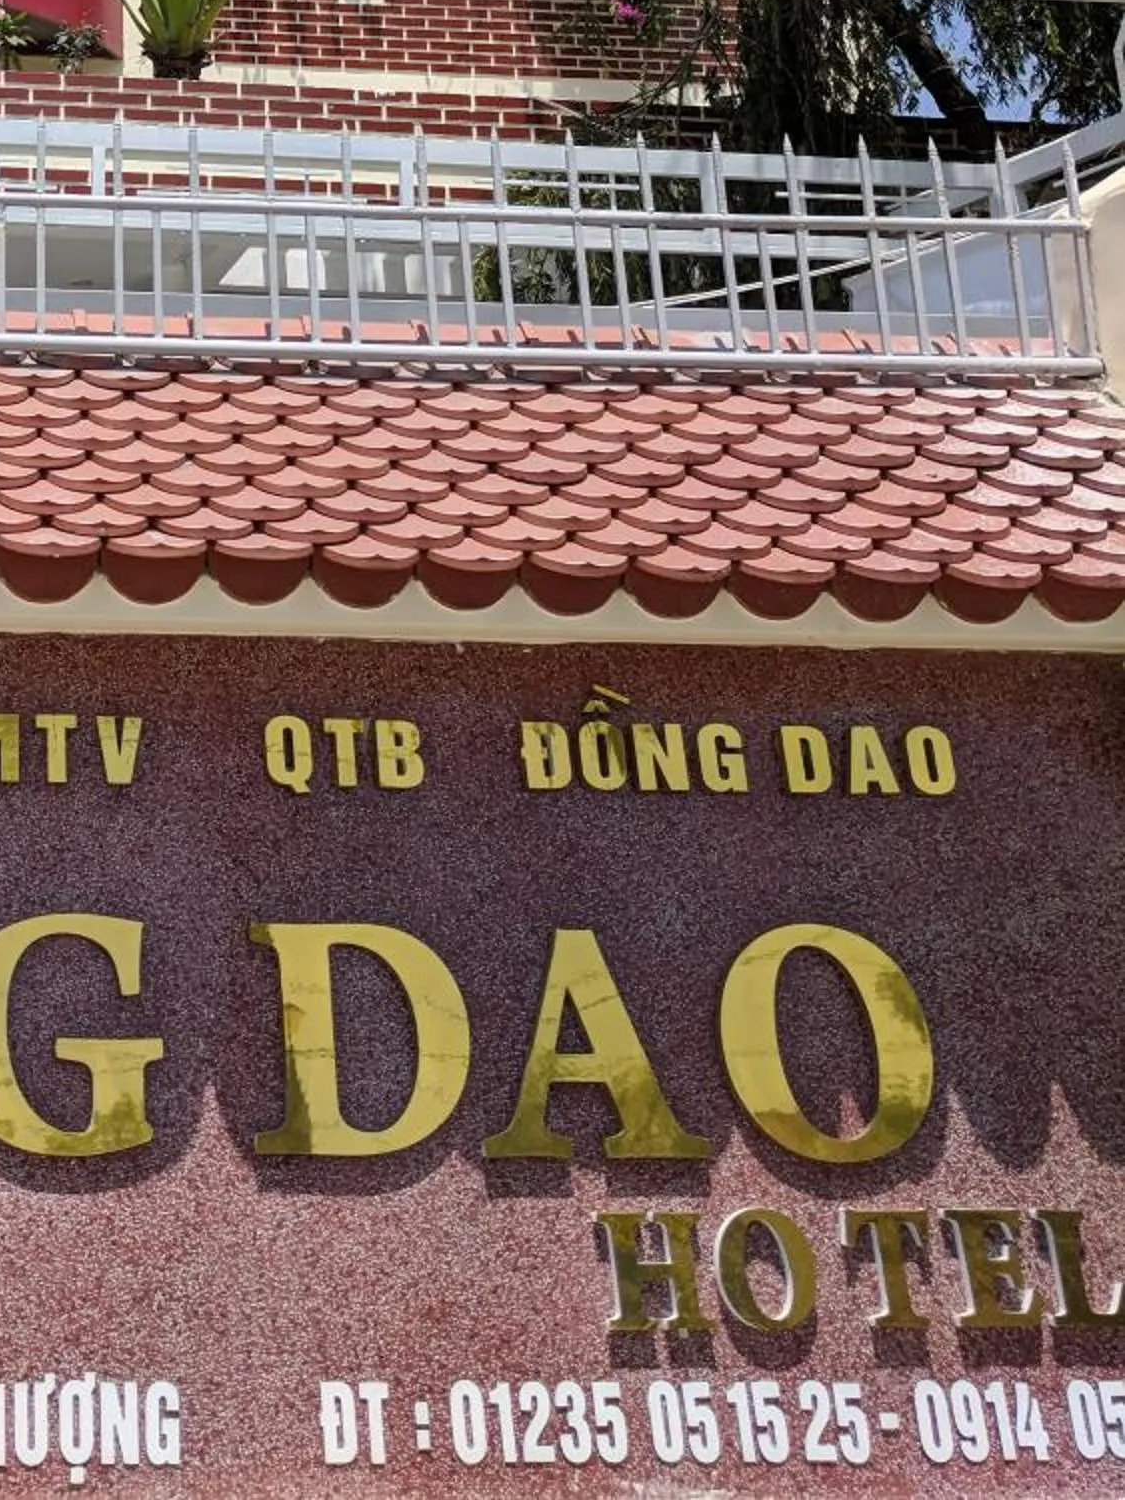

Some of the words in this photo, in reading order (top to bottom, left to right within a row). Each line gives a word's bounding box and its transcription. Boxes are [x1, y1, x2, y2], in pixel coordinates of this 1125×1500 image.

[264, 715, 427, 794] QTB
[520, 684, 750, 795] ĐỒNG
[777, 725, 959, 797] DAO
[249, 923, 935, 1164] DAO
[593, 1206, 1125, 1336] HOTEL
[449, 1380, 629, 1464] 01235
